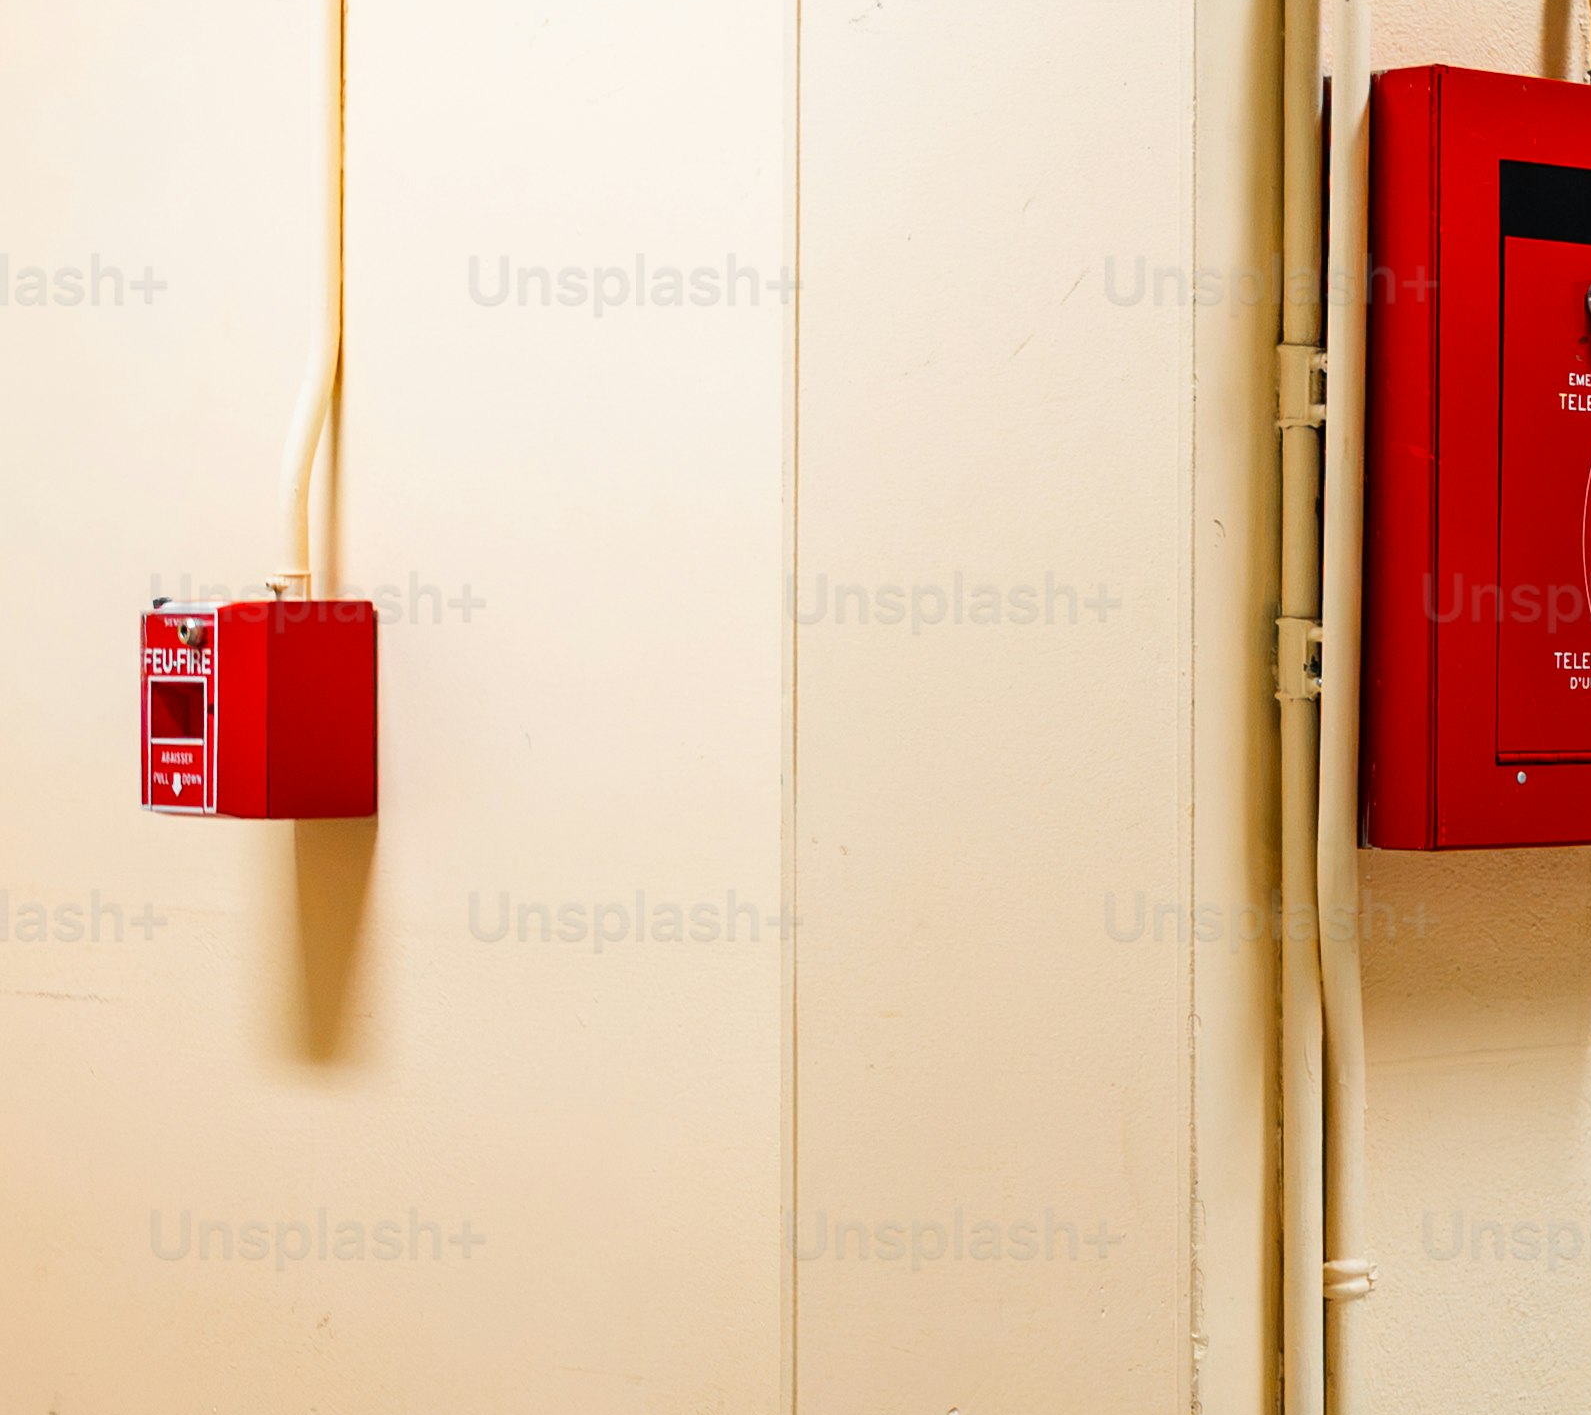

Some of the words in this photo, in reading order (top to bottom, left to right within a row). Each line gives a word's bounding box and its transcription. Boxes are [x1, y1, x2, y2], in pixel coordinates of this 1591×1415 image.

[161, 751, 194, 765] ABAISSER
[153, 771, 170, 785] PULL
[181, 772, 202, 787] DOWN
